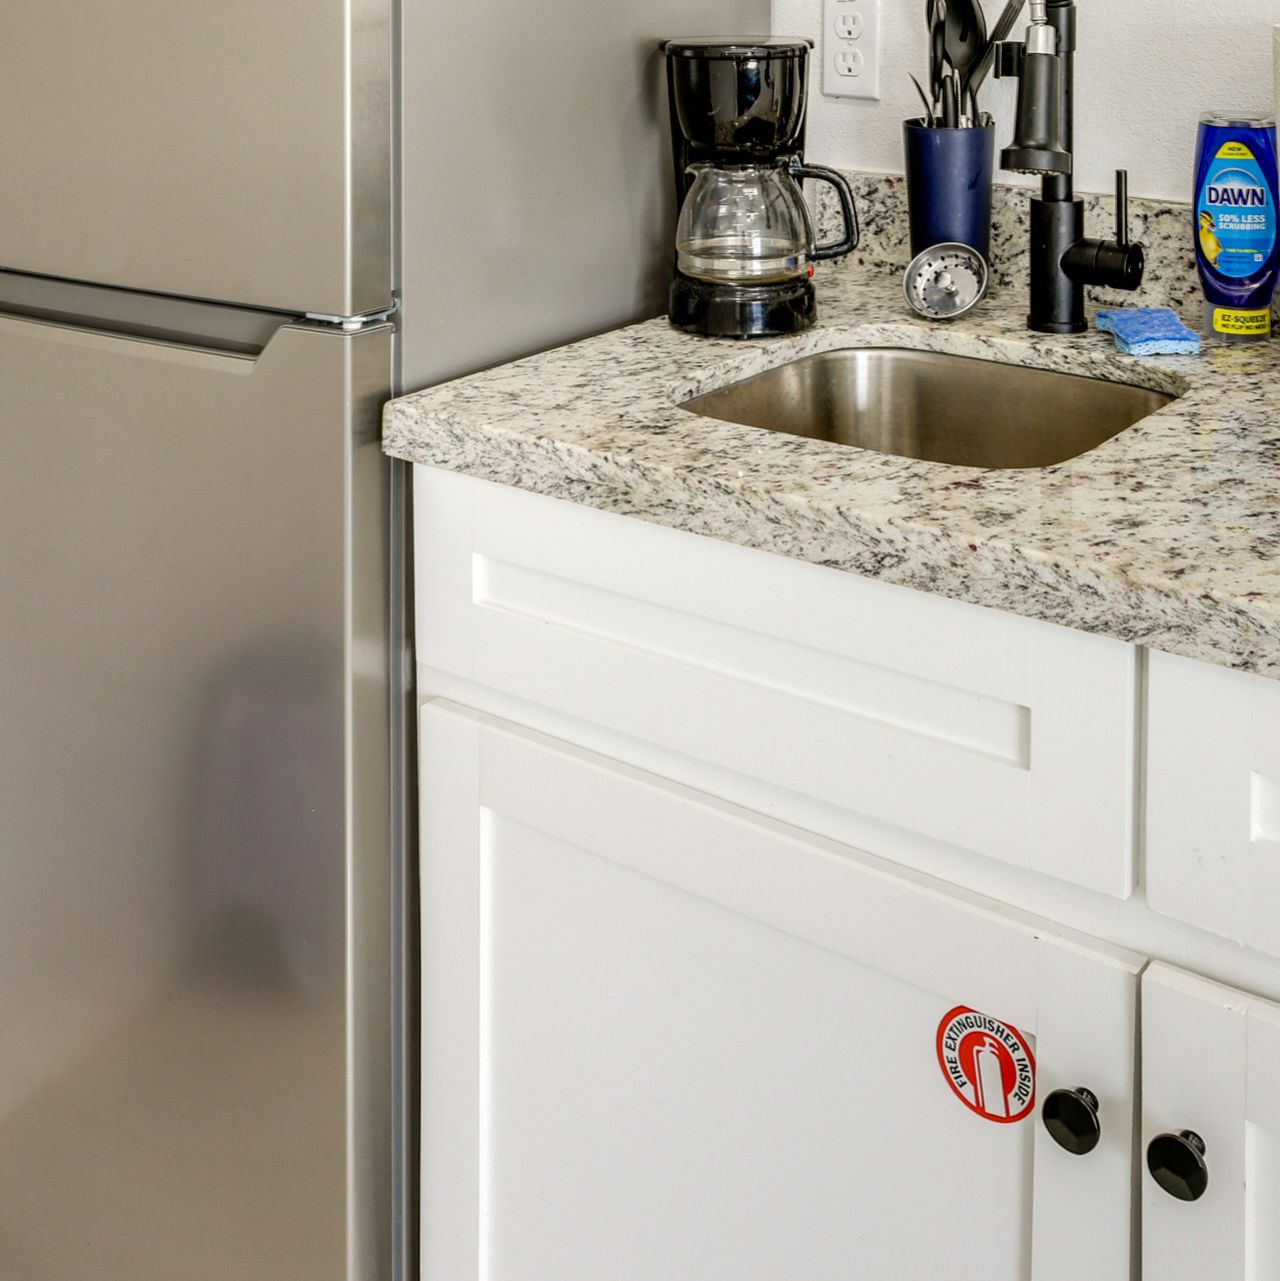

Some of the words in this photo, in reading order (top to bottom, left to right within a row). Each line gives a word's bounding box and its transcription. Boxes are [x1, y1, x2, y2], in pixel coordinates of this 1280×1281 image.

[1207, 185, 1265, 207] DAWN
[1218, 214, 1239, 223] 50%
[1241, 214, 1266, 223] LESS
[1218, 222, 1267, 230] SCRUBBING
[945, 1015, 1020, 1054] EXTINGUISHER
[946, 1055, 967, 1088] FIRE
[1013, 1058, 1031, 1106] INSIDE
